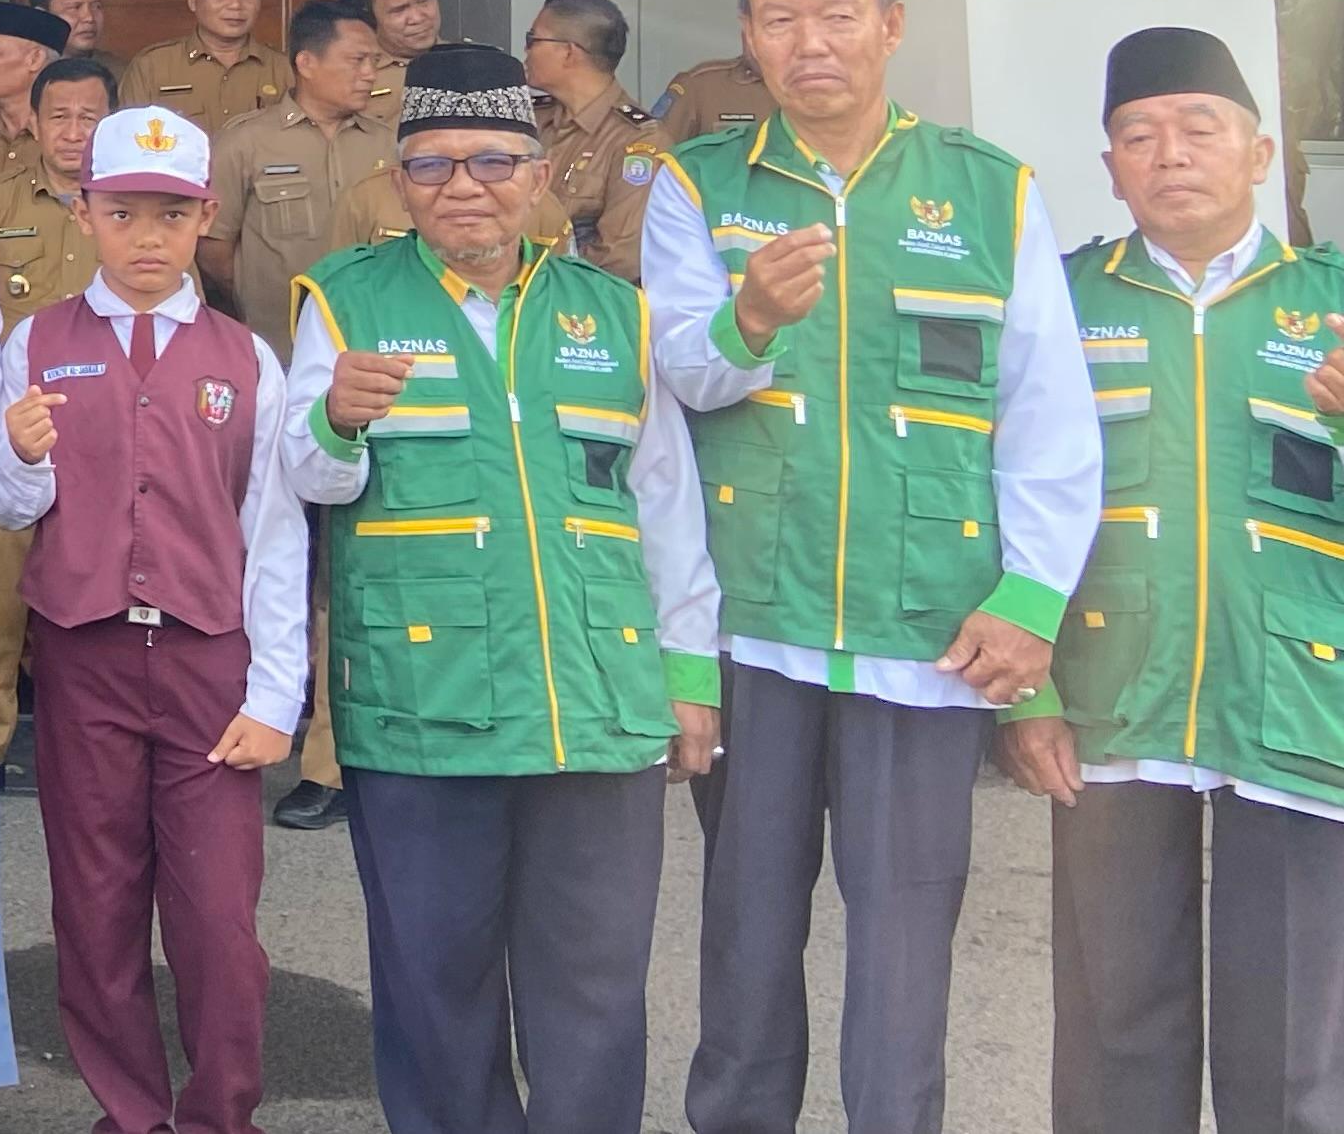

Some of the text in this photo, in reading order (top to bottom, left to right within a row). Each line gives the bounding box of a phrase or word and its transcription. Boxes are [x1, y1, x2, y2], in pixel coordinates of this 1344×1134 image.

[721, 212, 789, 235] BAZNAS
[907, 228, 962, 247] BAZNAS
[1079, 325, 1140, 339] AZNAS
[378, 339, 448, 354] BAZNAS
[560, 346, 609, 360] BAZNAS
[1266, 340, 1323, 362] BAZNAS
